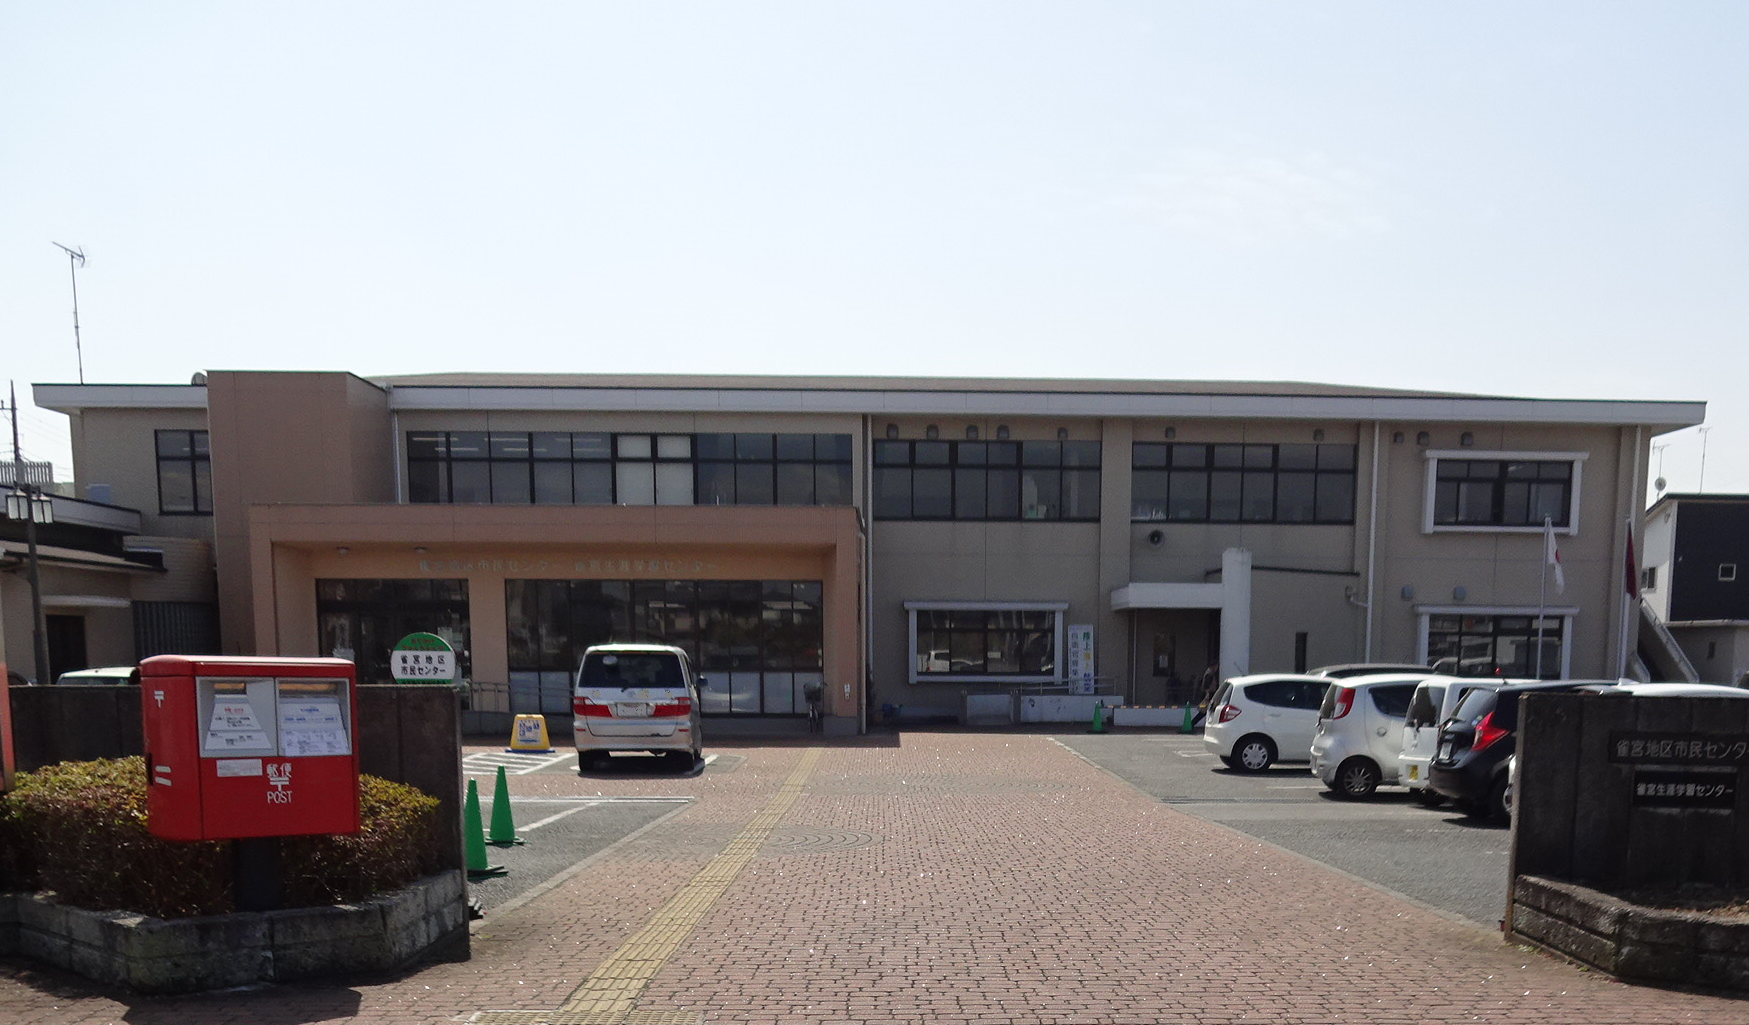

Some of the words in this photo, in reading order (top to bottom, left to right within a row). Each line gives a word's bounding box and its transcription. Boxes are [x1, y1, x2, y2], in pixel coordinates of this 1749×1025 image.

[401, 665, 446, 676] 市民センター
[1616, 739, 1749, 759] 雀宮地区市民センタ
[266, 790, 293, 804] POST
